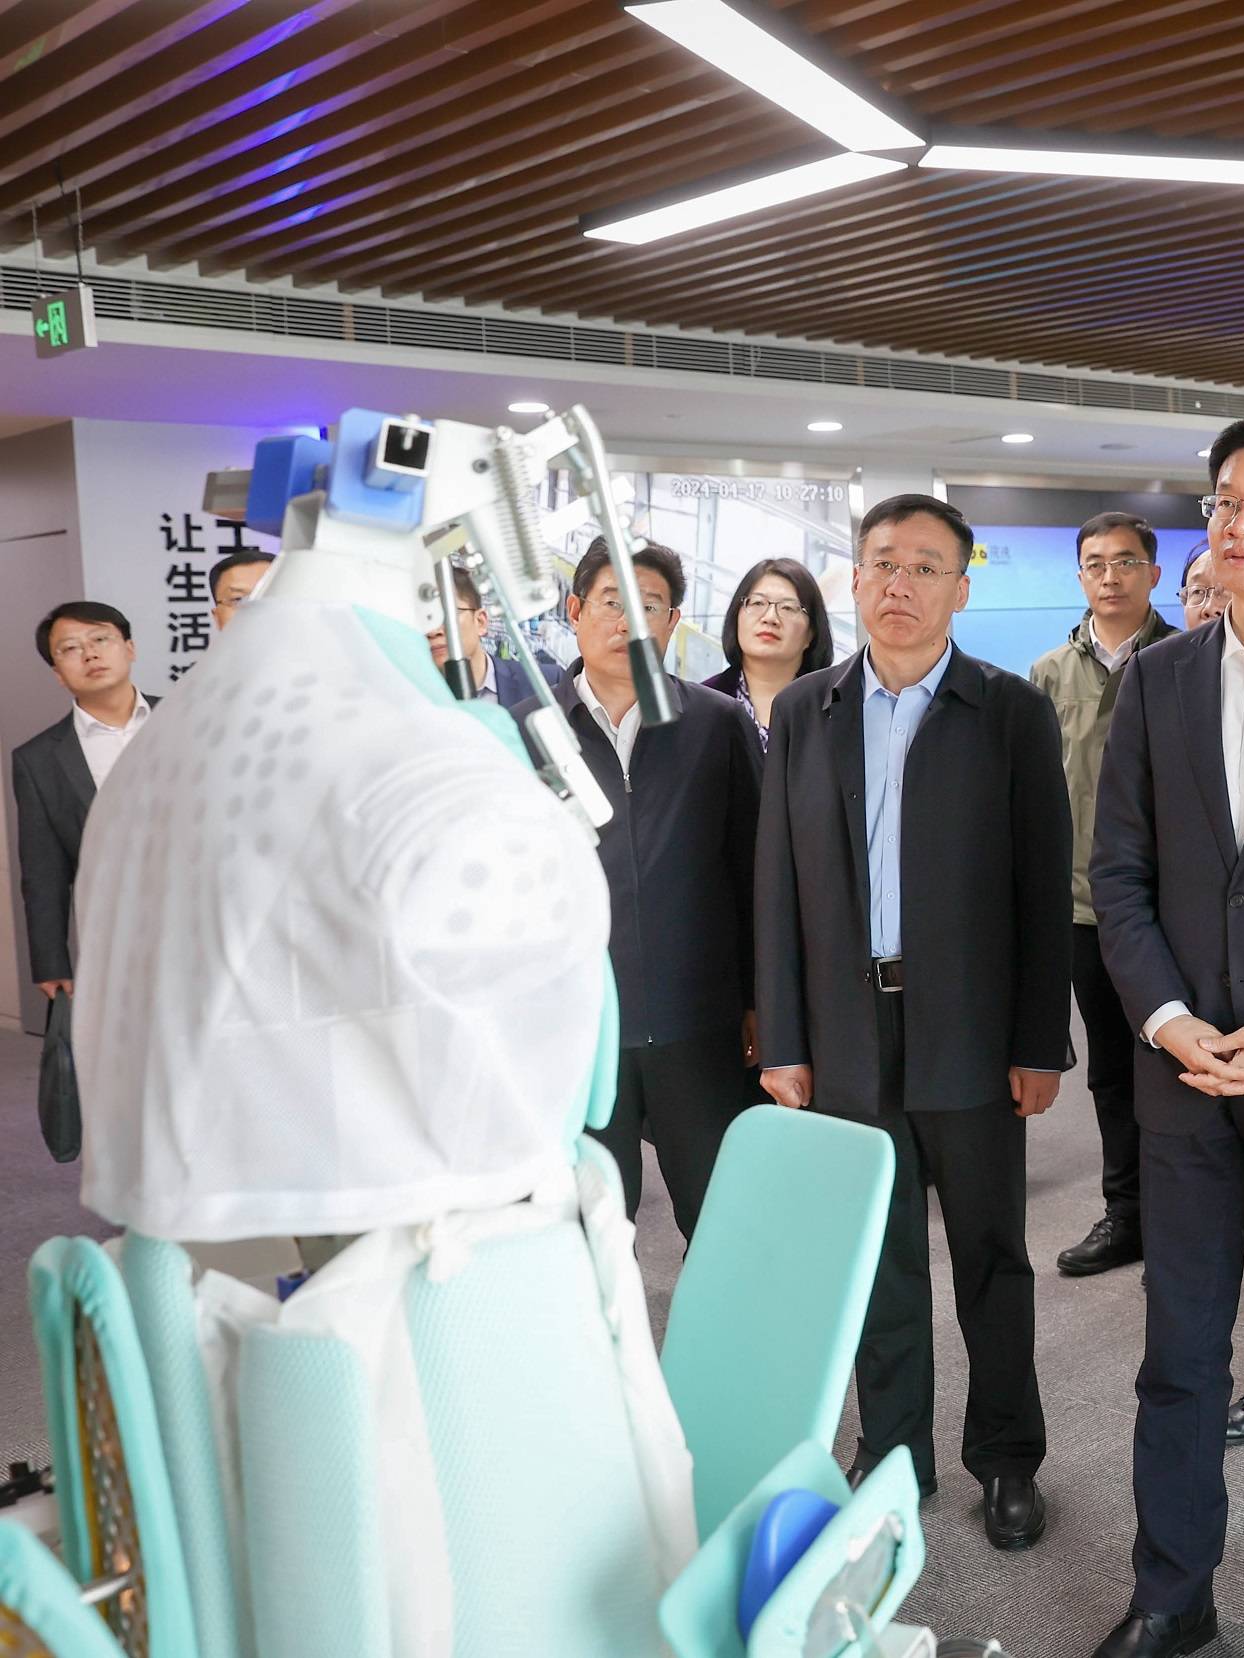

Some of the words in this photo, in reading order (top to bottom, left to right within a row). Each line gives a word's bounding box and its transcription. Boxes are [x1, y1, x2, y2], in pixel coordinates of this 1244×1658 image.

[671, 479, 767, 498] 2024-04-17
[160, 513, 210, 682] 让生活
